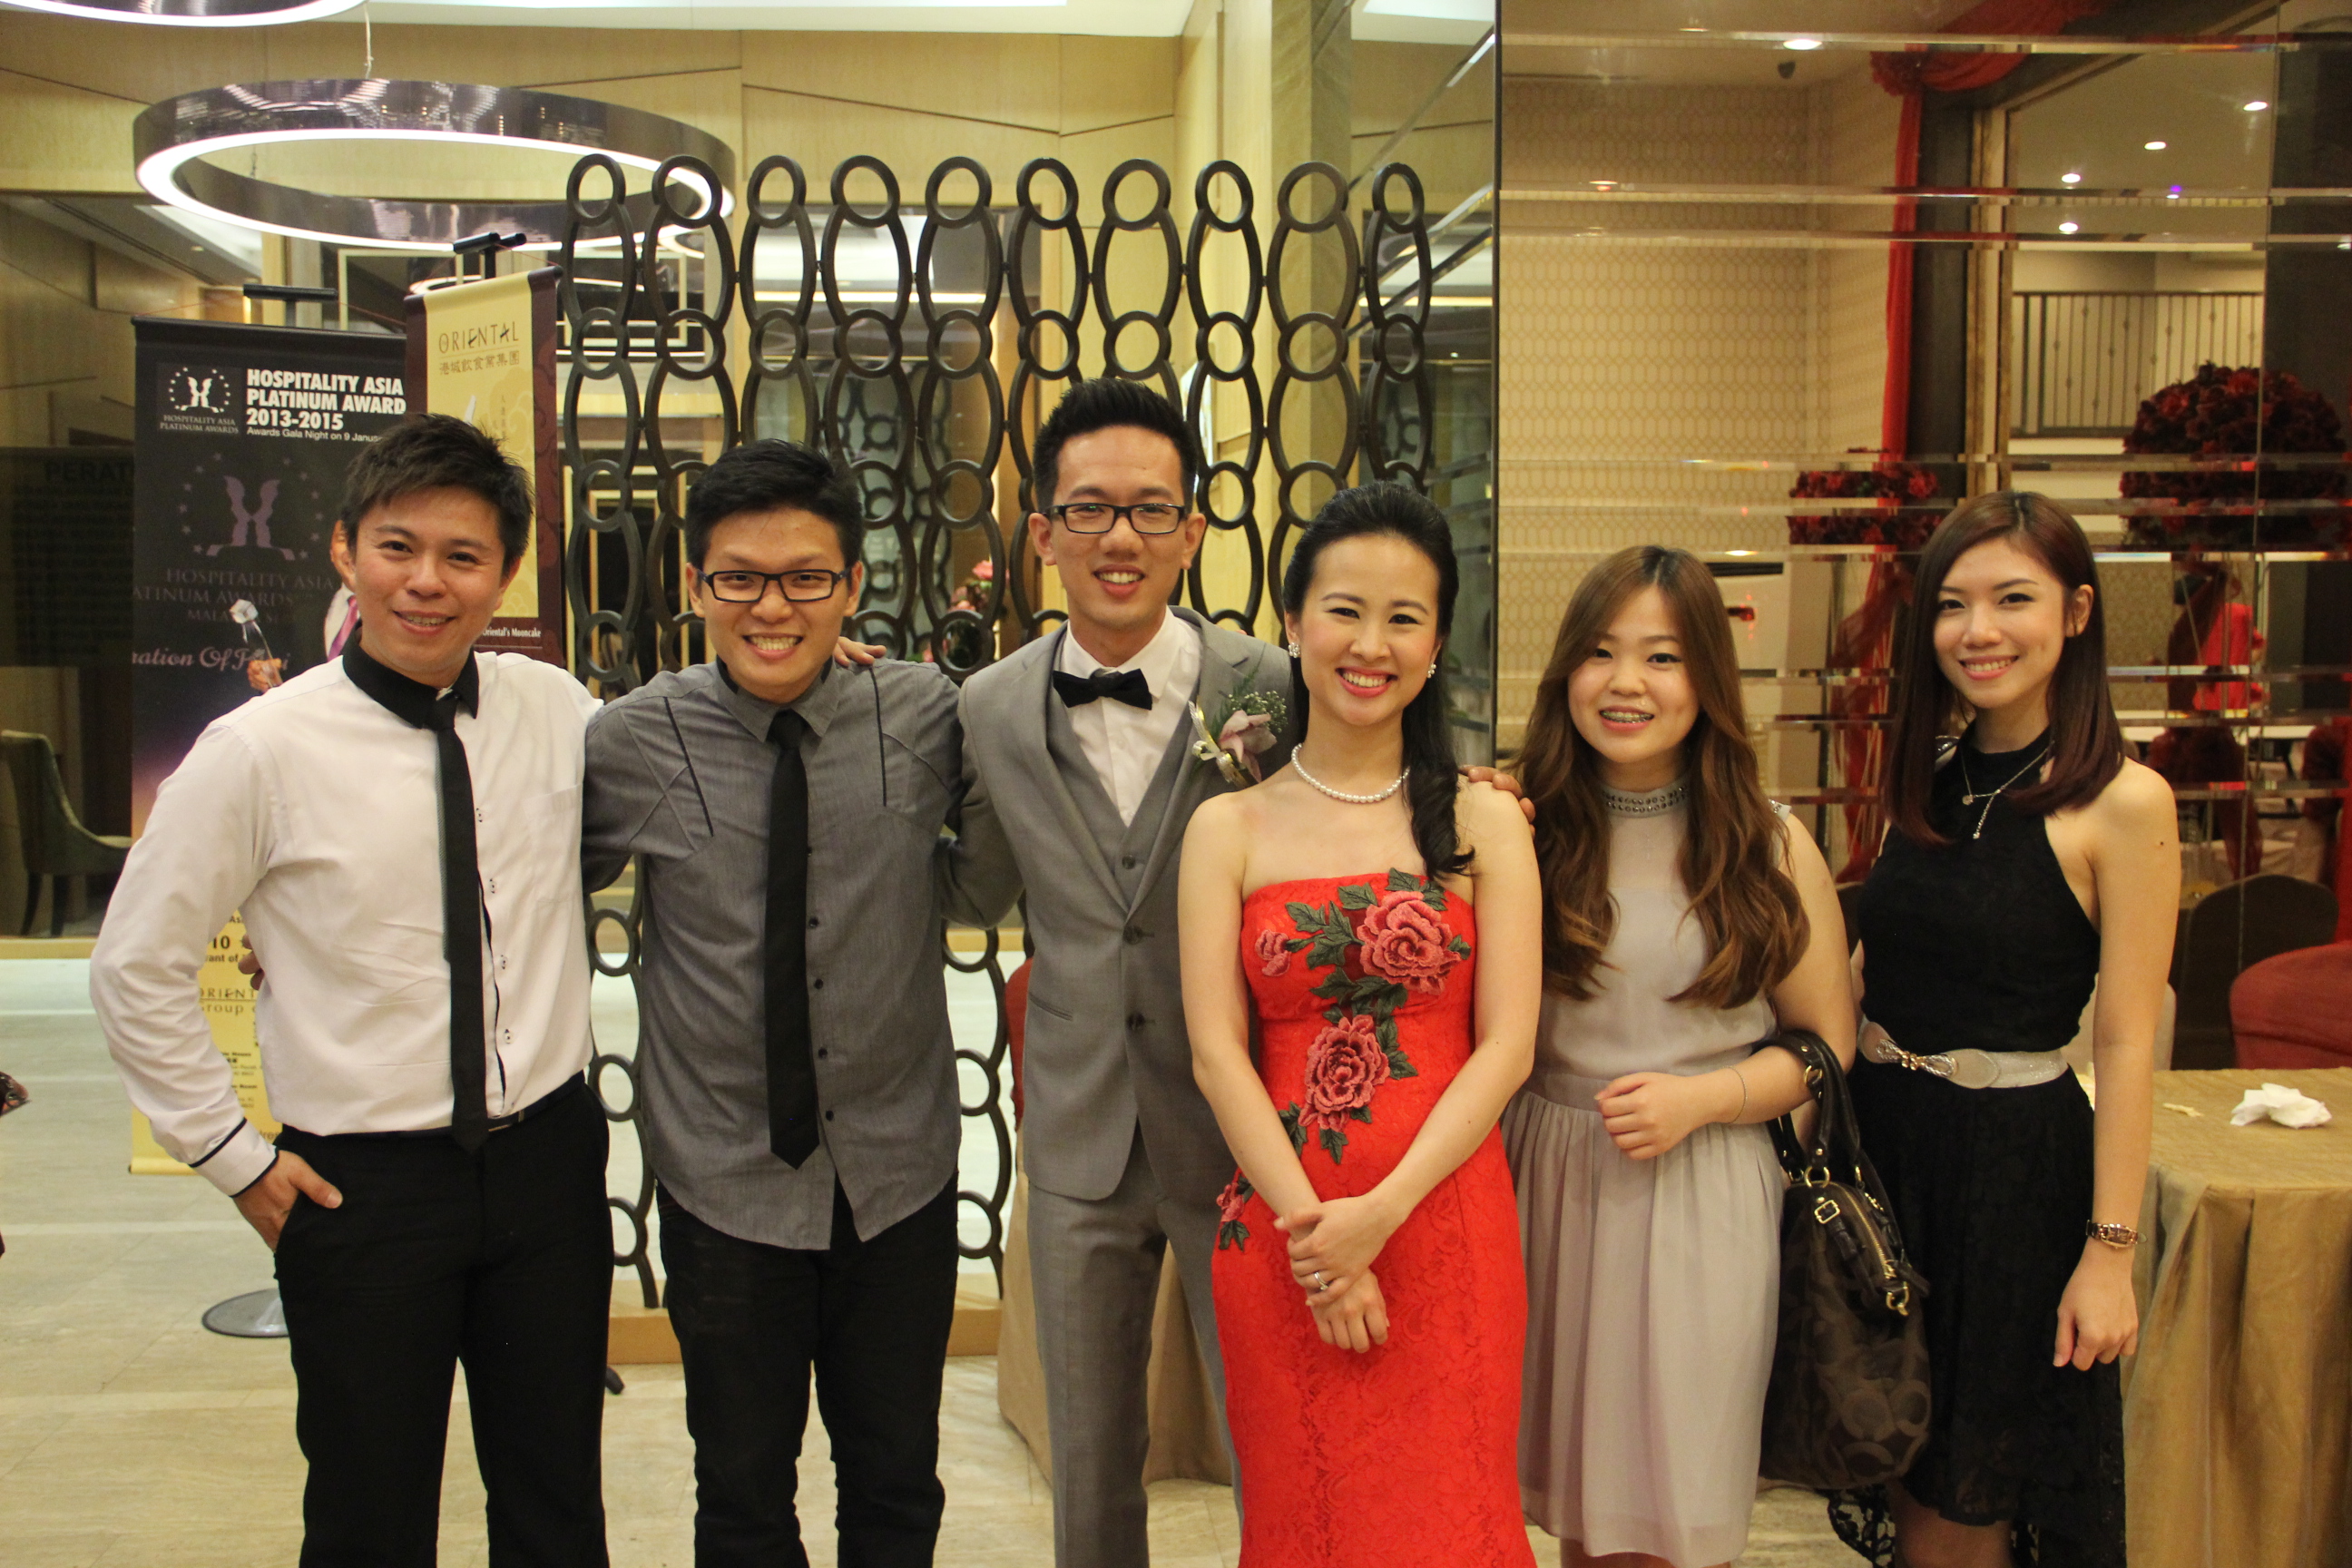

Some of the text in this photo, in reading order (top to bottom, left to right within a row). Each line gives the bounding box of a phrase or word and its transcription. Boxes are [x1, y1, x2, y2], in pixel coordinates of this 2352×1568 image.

[438, 320, 519, 354] ORIENTAL
[246, 368, 405, 396] HOSPITALITY ASIA
[246, 387, 407, 415] PLATINUM AWARD
[159, 422, 239, 435] PLATINUM AWARDS
[163, 414, 236, 426] HOSPITALITY ASIA
[246, 407, 345, 431] 2013-2015
[246, 426, 280, 437] Awards
[281, 428, 303, 438] Gala
[305, 430, 328, 441] Night
[329, 432, 343, 440] on
[343, 432, 350, 441] 9
[167, 568, 334, 590] HOSPITALITY ASIA
[511, 626, 542, 638] Mooncake
[199, 646, 232, 671] Of
